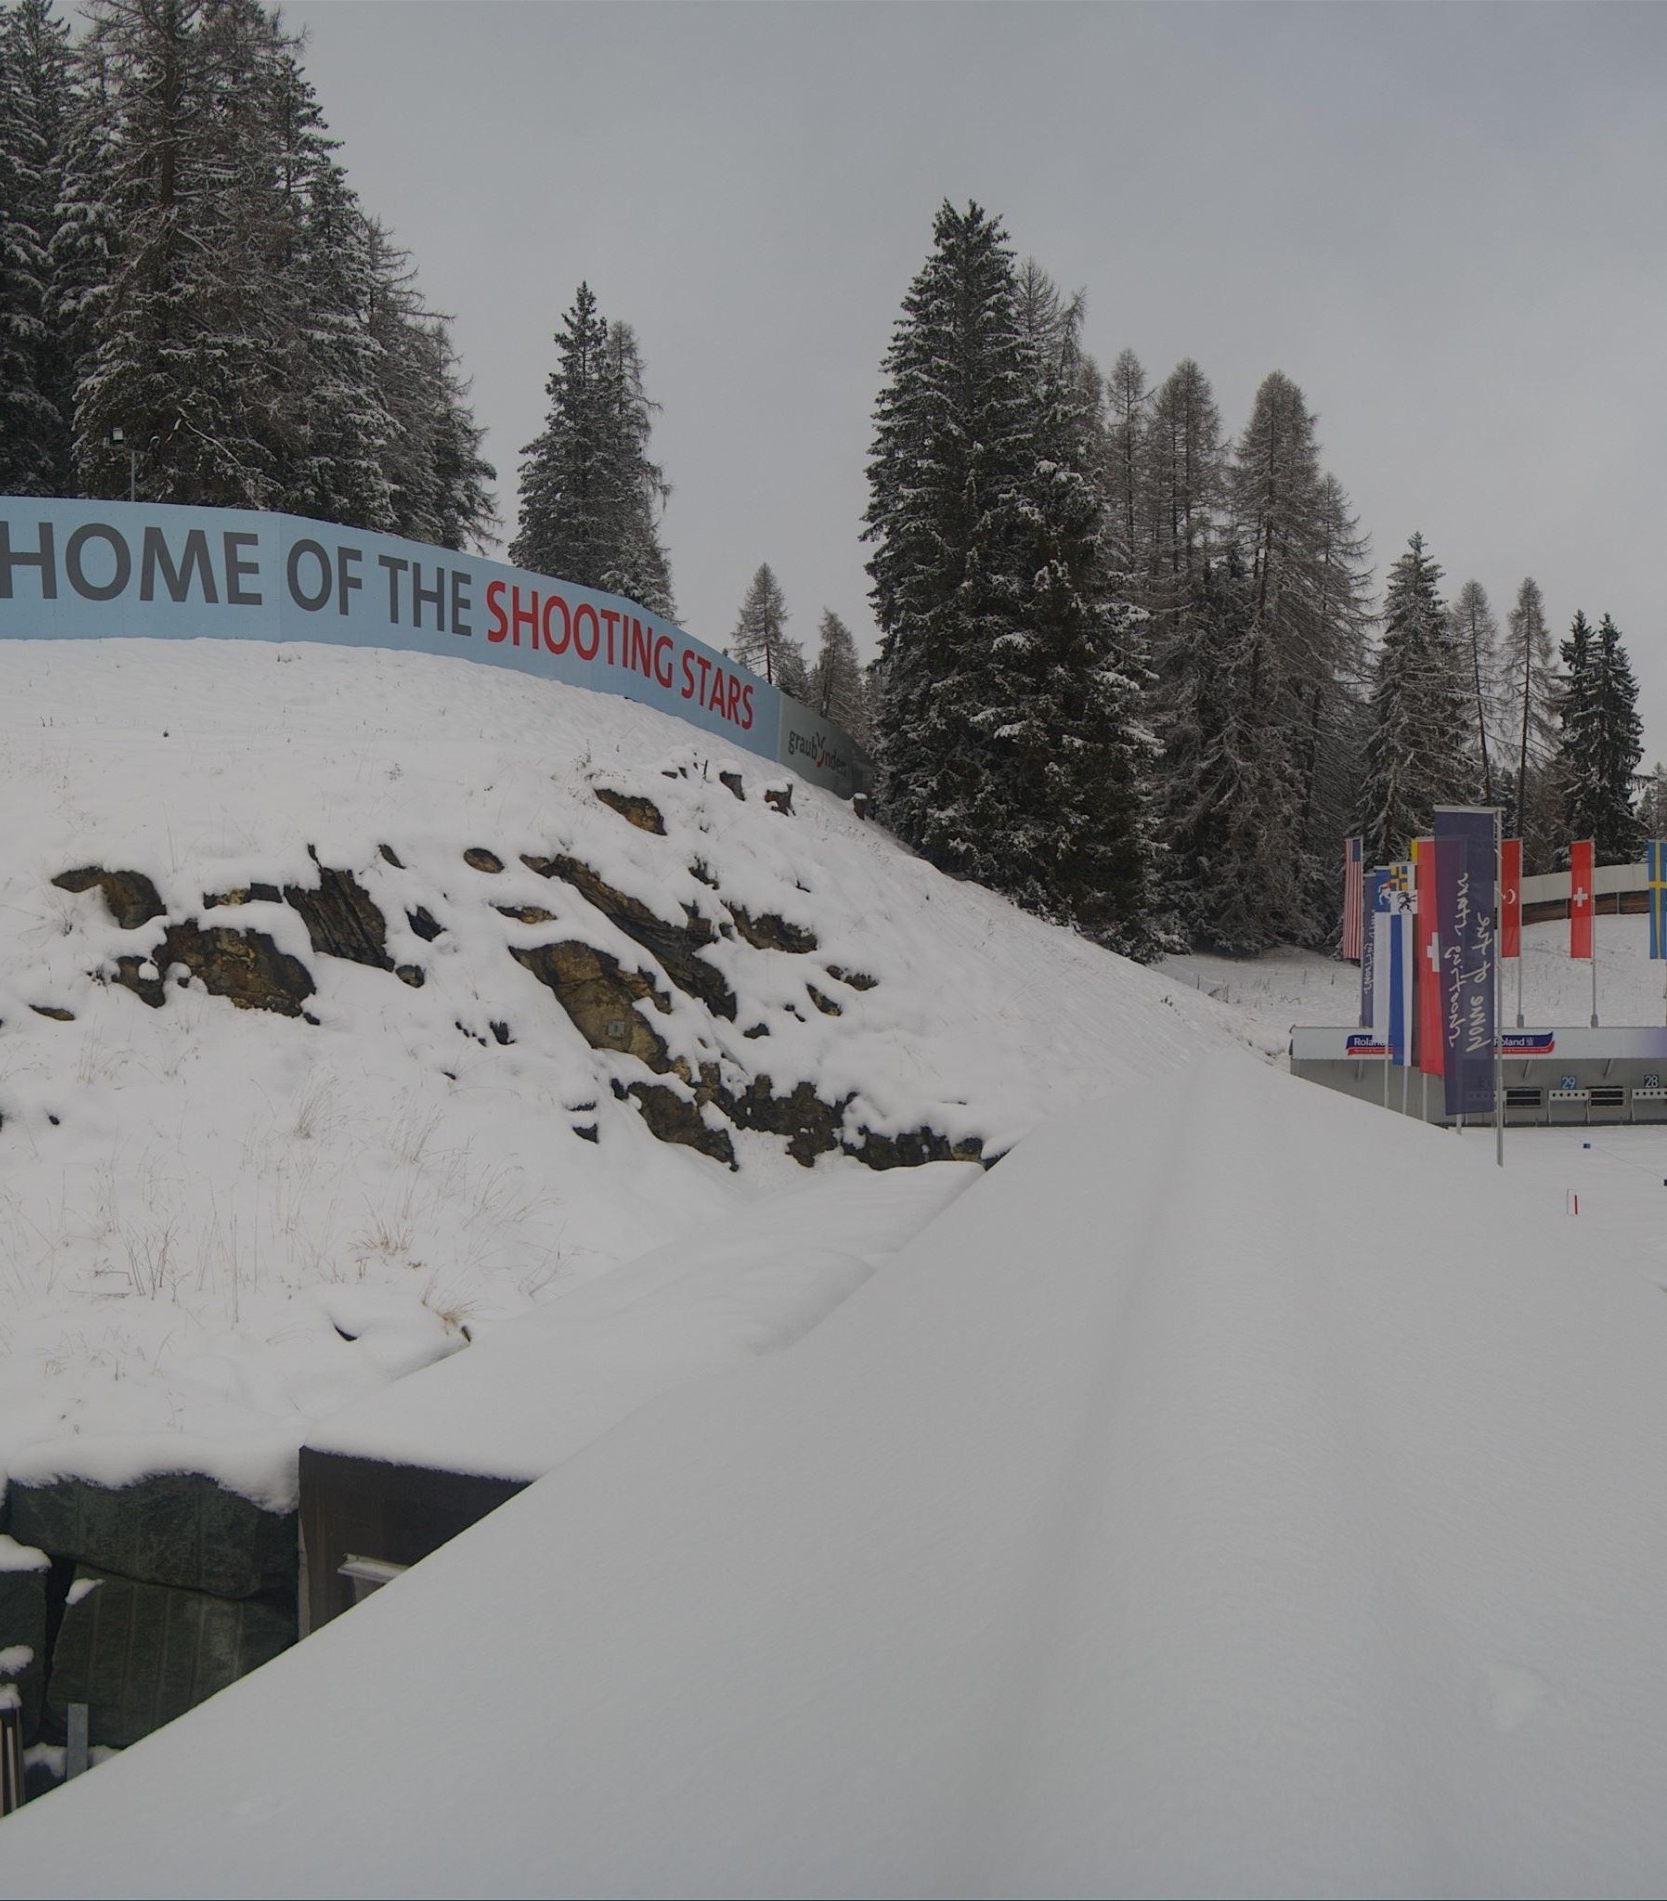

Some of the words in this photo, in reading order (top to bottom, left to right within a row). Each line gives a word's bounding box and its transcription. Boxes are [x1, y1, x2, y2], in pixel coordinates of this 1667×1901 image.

[287, 538, 363, 615] OF
[378, 554, 472, 636] THE
[486, 580, 674, 688] SHOOTING
[681, 649, 754, 730] STARS
[1561, 1076, 1576, 1090] 29
[1644, 1075, 1659, 1088] 28
